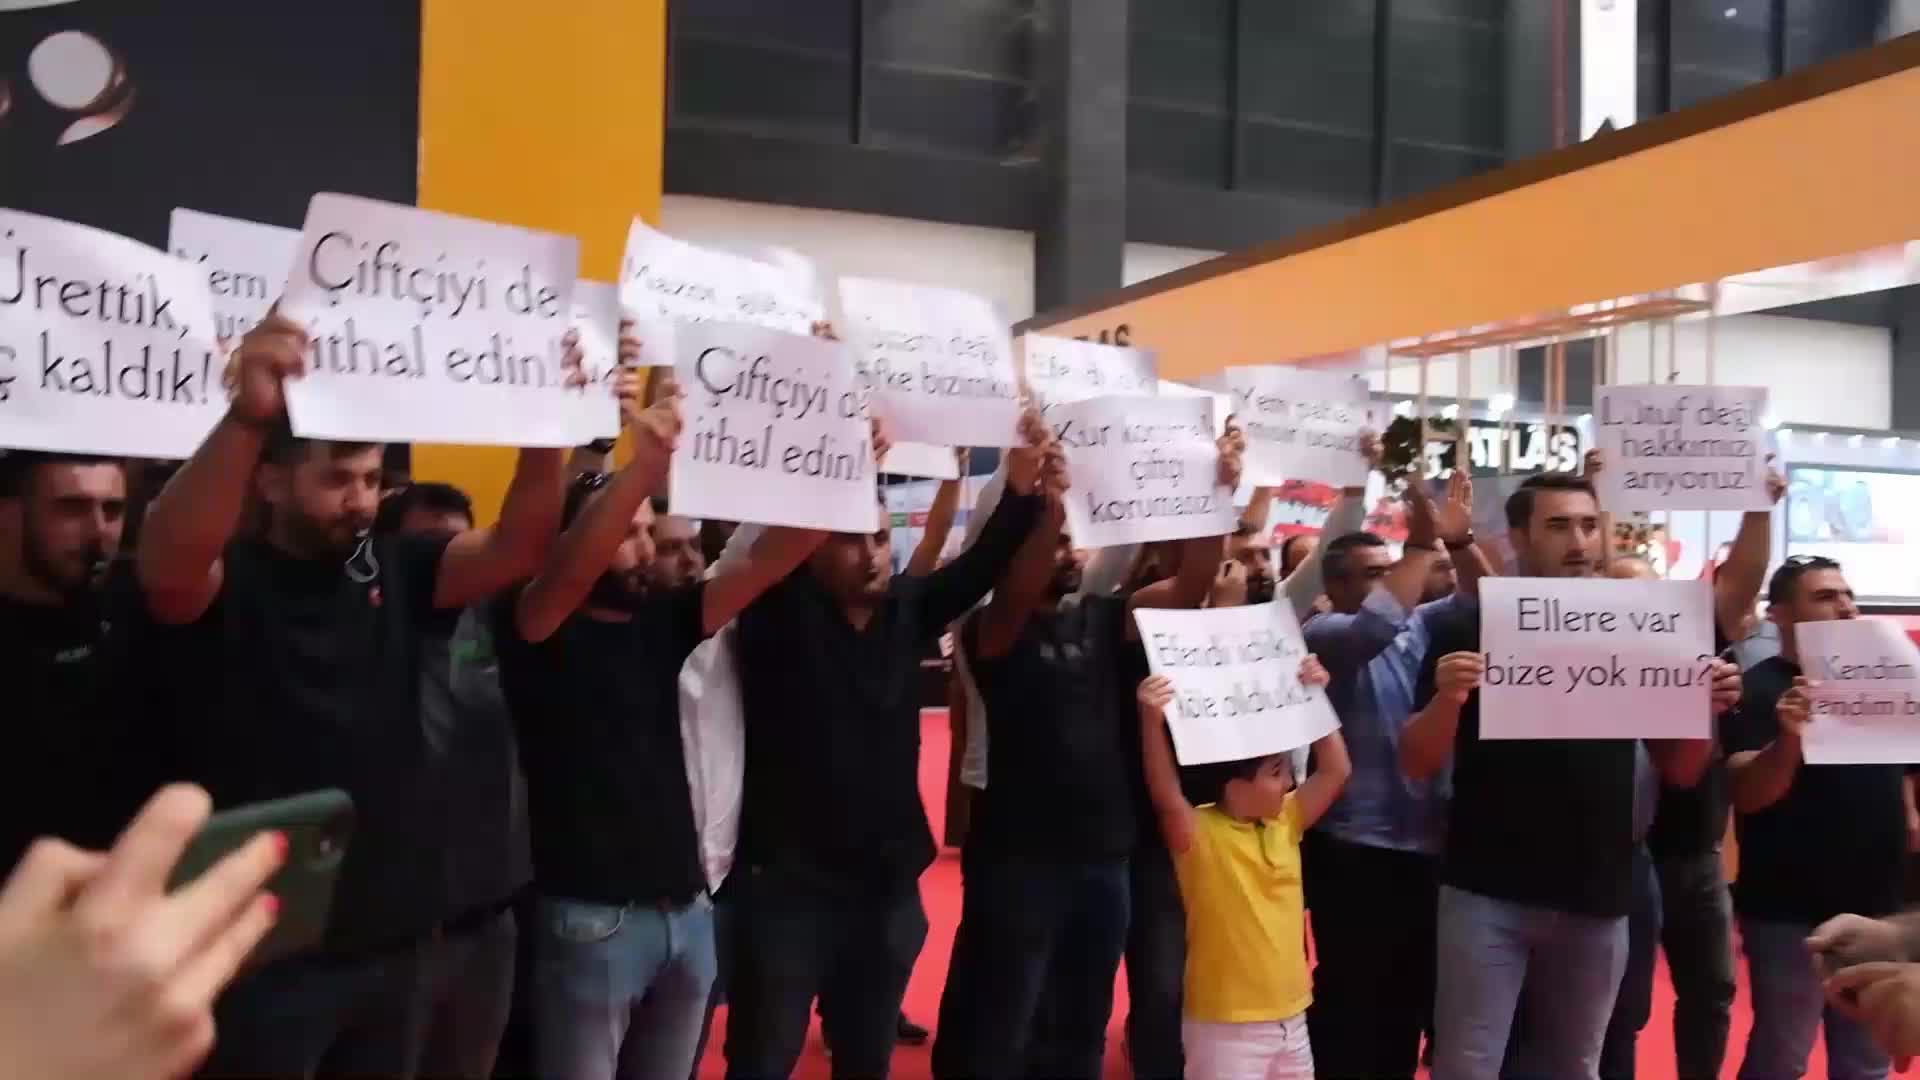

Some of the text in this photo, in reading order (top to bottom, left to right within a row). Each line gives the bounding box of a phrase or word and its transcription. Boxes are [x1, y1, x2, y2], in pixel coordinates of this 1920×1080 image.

[309, 231, 561, 319] Çiftçiyi de
[40, 328, 213, 404] kaldık!
[310, 317, 426, 378] ithal
[696, 346, 831, 420] Çiftçiyi
[693, 415, 868, 481] ithal edin!
[1465, 422, 1578, 472] ATLAS
[1517, 597, 1680, 633] Ellere var
[1484, 653, 1711, 694] bize yok mu?
